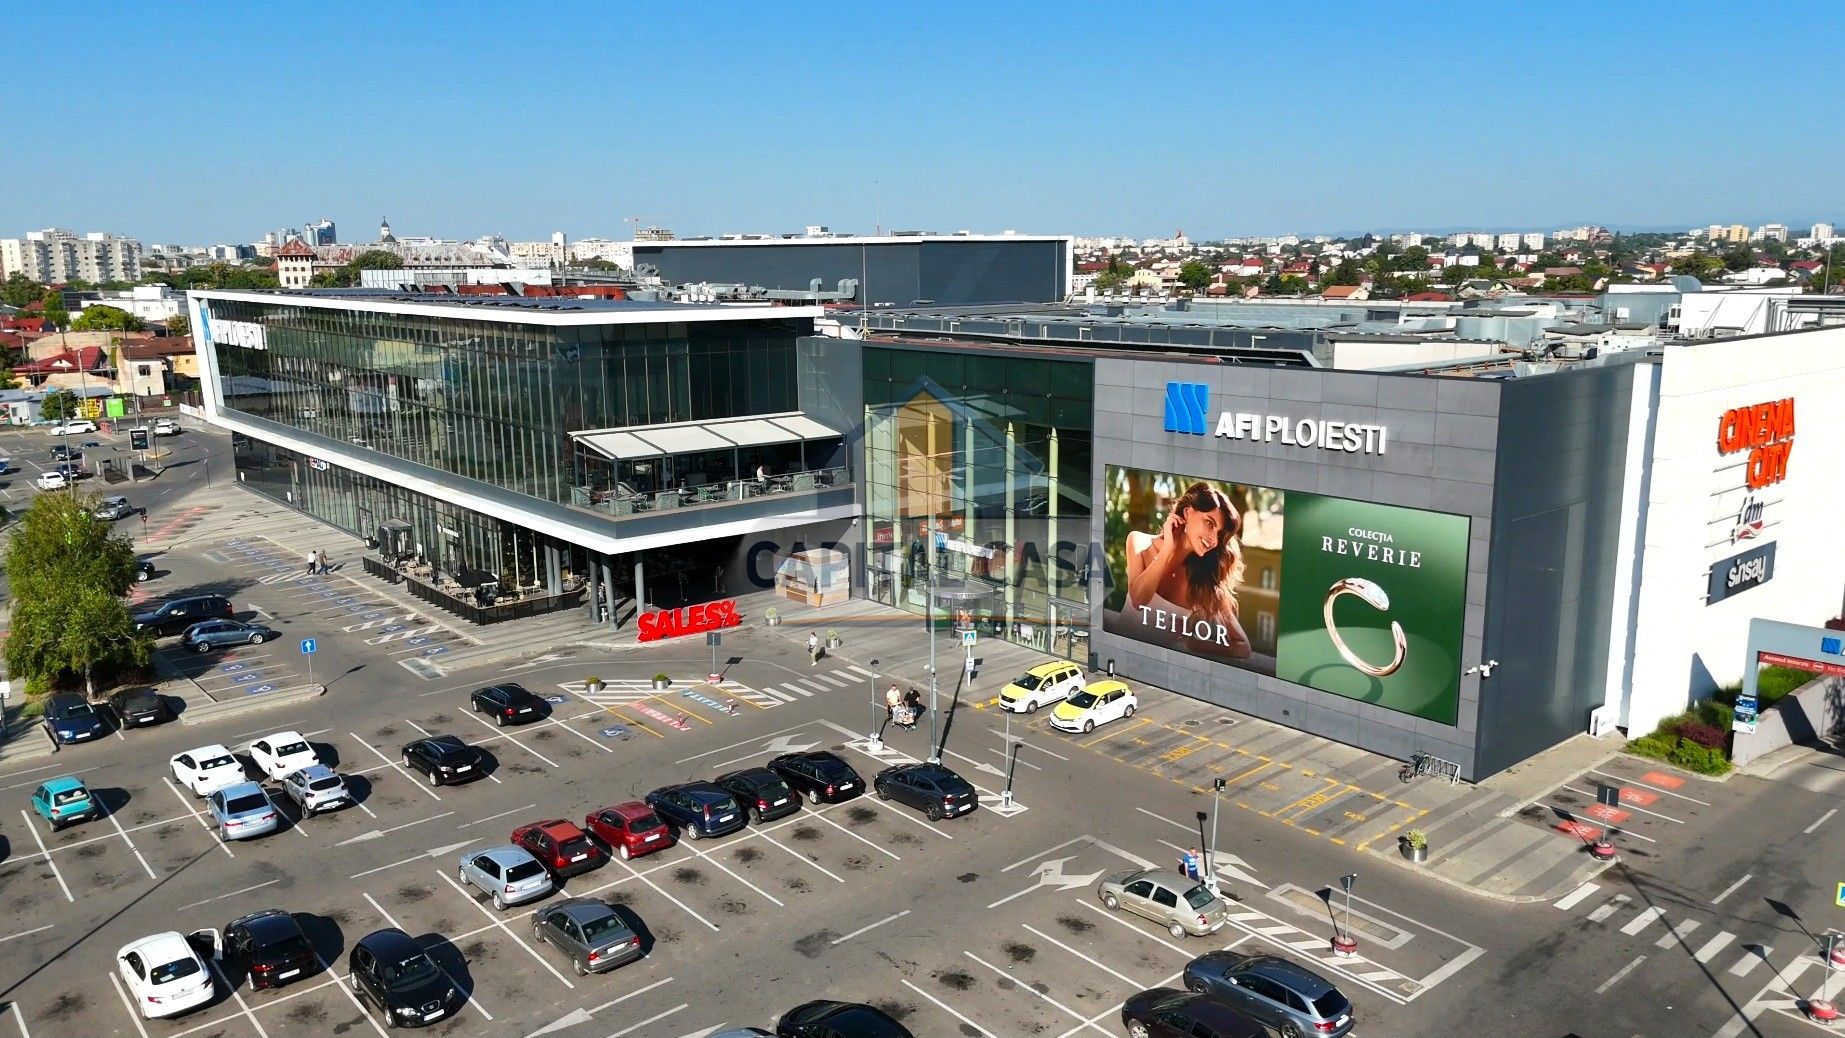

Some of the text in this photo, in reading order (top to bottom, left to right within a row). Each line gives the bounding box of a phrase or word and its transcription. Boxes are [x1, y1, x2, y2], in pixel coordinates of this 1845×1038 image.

[1215, 411, 1387, 455] AFI PLOIESTI
[1718, 397, 1795, 456] CINEMA
[1746, 440, 1794, 491] CITY
[1742, 496, 1764, 525] dm
[1321, 536, 1422, 568] REVERIE
[1727, 556, 1767, 588] sinsay
[637, 599, 742, 643] SALES%
[1138, 604, 1230, 647] TEILOR
